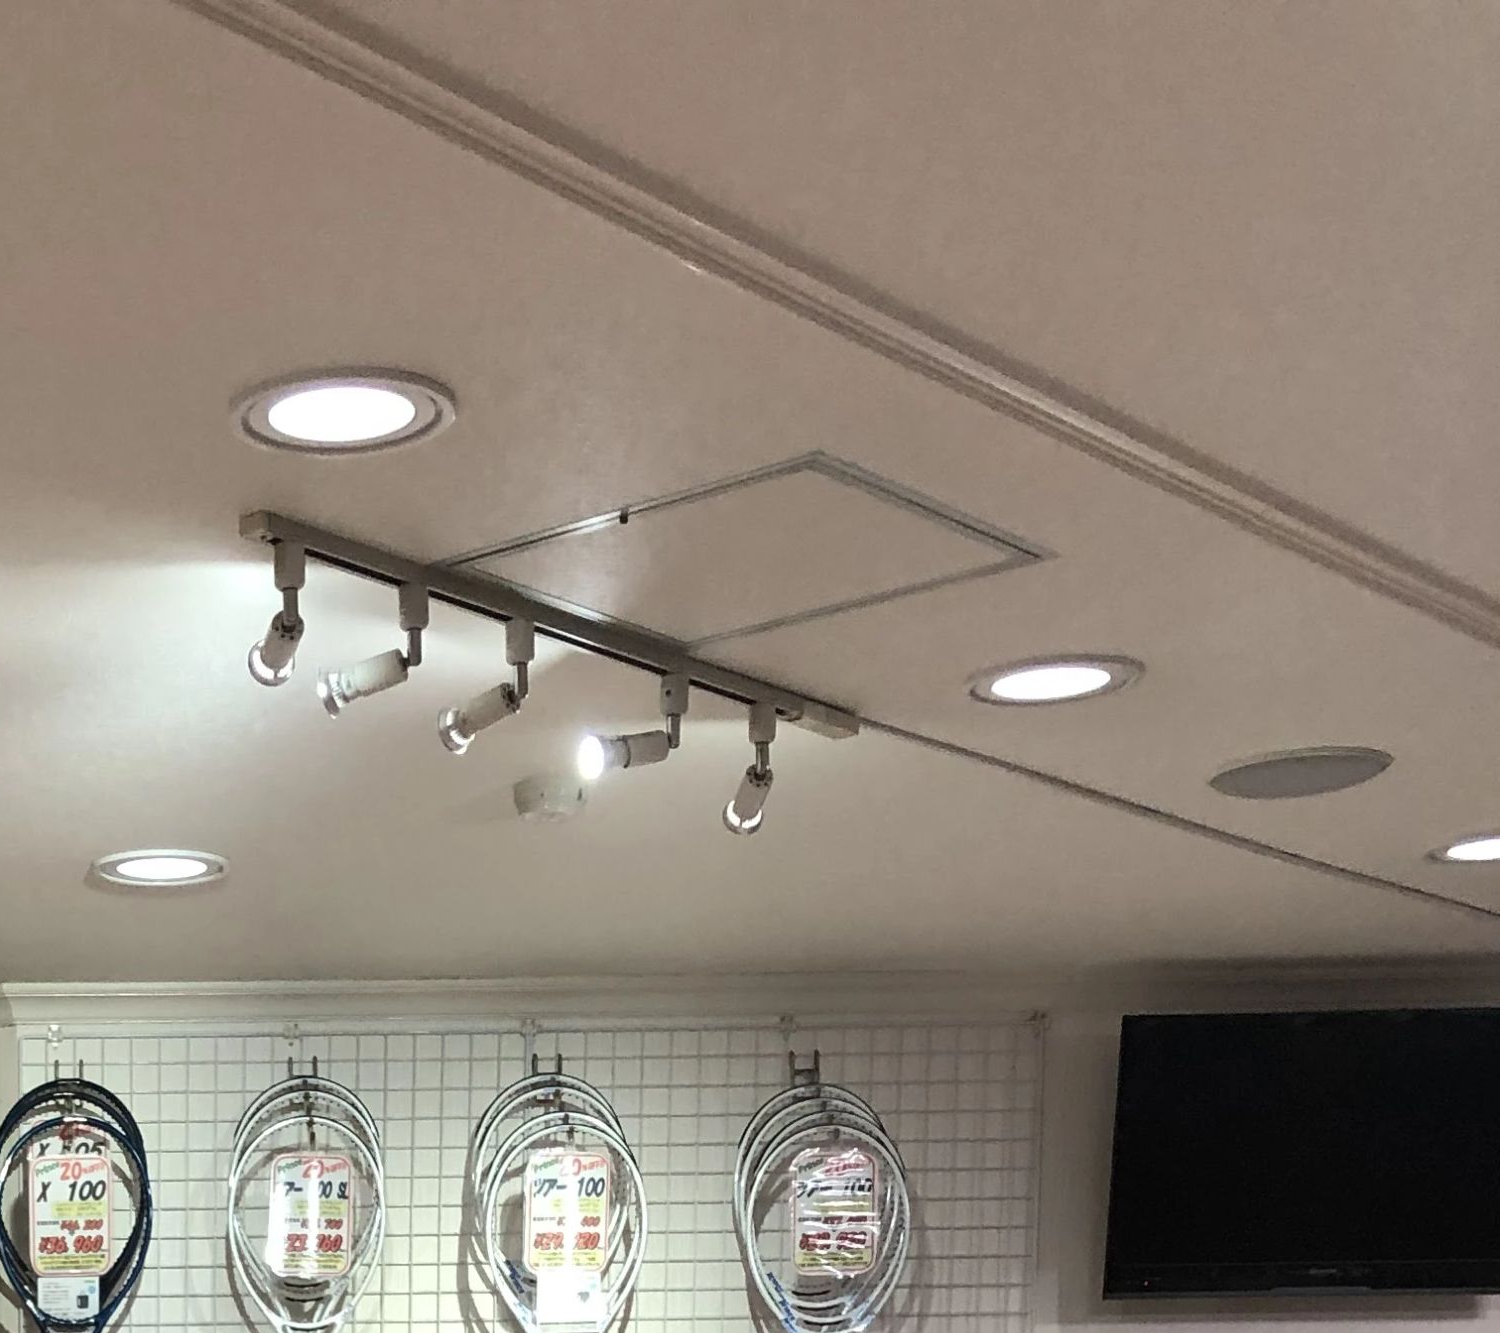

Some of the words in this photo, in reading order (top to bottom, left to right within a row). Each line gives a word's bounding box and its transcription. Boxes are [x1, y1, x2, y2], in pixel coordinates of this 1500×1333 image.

[37, 1181, 52, 1202] X
[68, 1179, 106, 1202] 100
[533, 1177, 567, 1198] ツアー
[577, 1176, 606, 1198] 100
